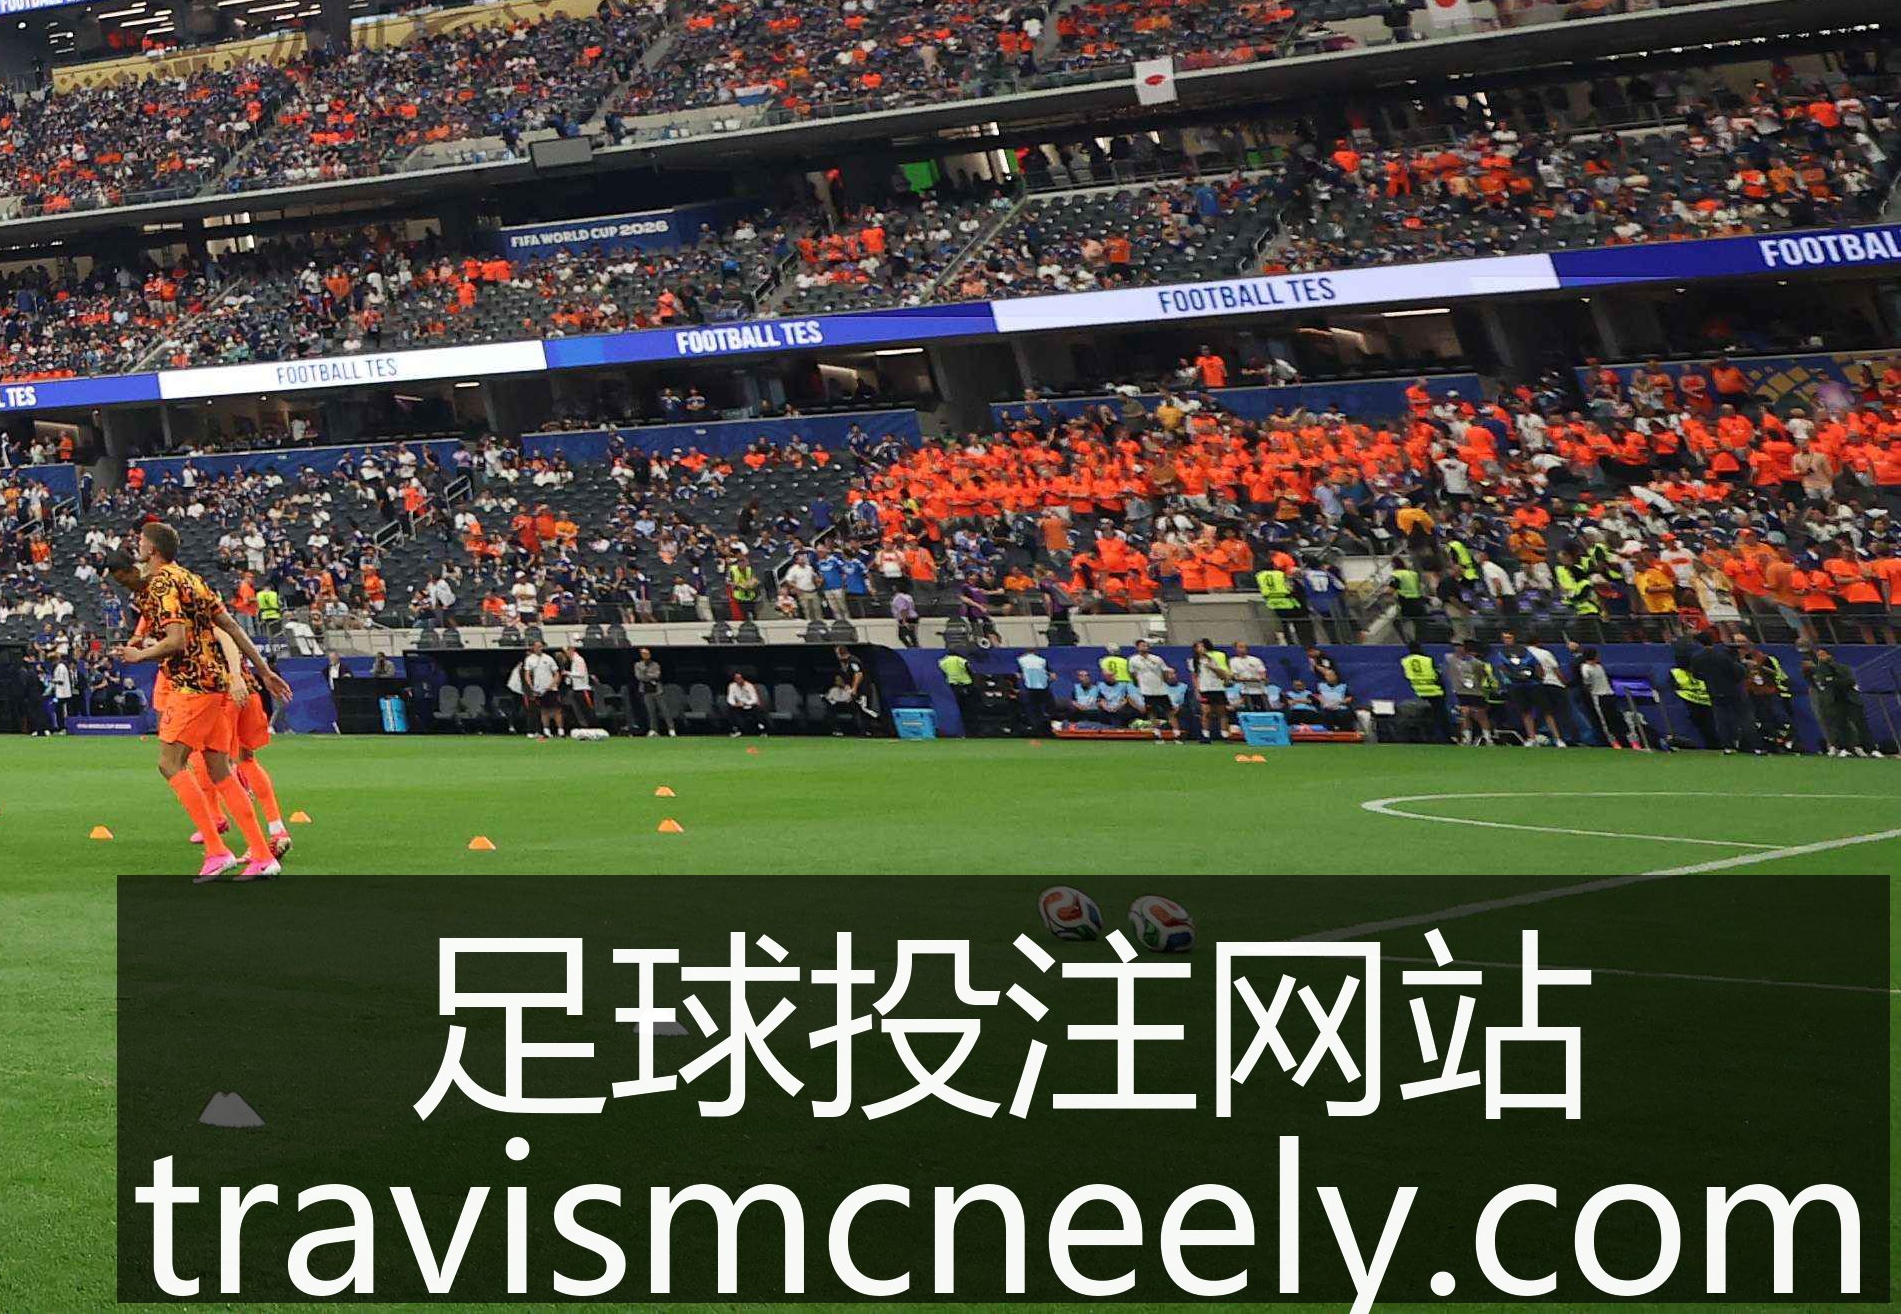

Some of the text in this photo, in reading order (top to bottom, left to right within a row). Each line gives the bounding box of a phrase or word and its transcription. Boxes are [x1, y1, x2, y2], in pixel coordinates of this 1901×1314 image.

[510, 220, 669, 248] FIFA WORLD CUP 2026
[1158, 282, 1284, 315] FOOTBALL
[677, 324, 781, 355] FOOTBALL
[277, 363, 361, 385] FOOTBALL
